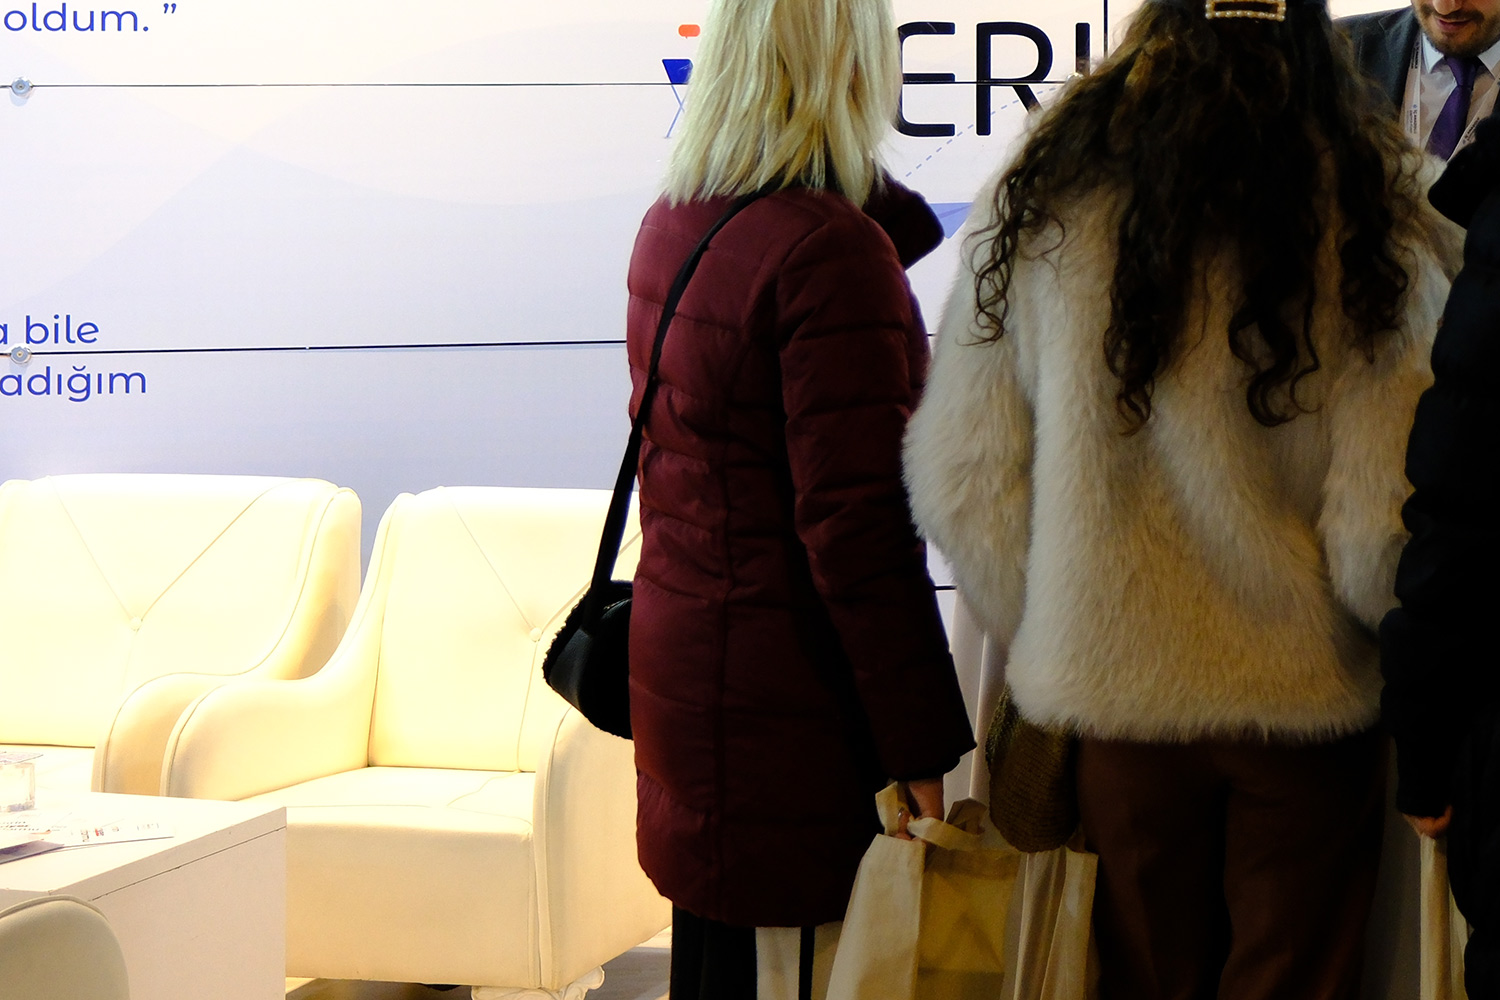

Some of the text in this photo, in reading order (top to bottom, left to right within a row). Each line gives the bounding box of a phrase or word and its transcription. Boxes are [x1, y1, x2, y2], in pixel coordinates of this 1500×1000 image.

[4, 2, 150, 32] oldum.
[25, 314, 100, 345] bile
[0, 365, 147, 403] adığım
